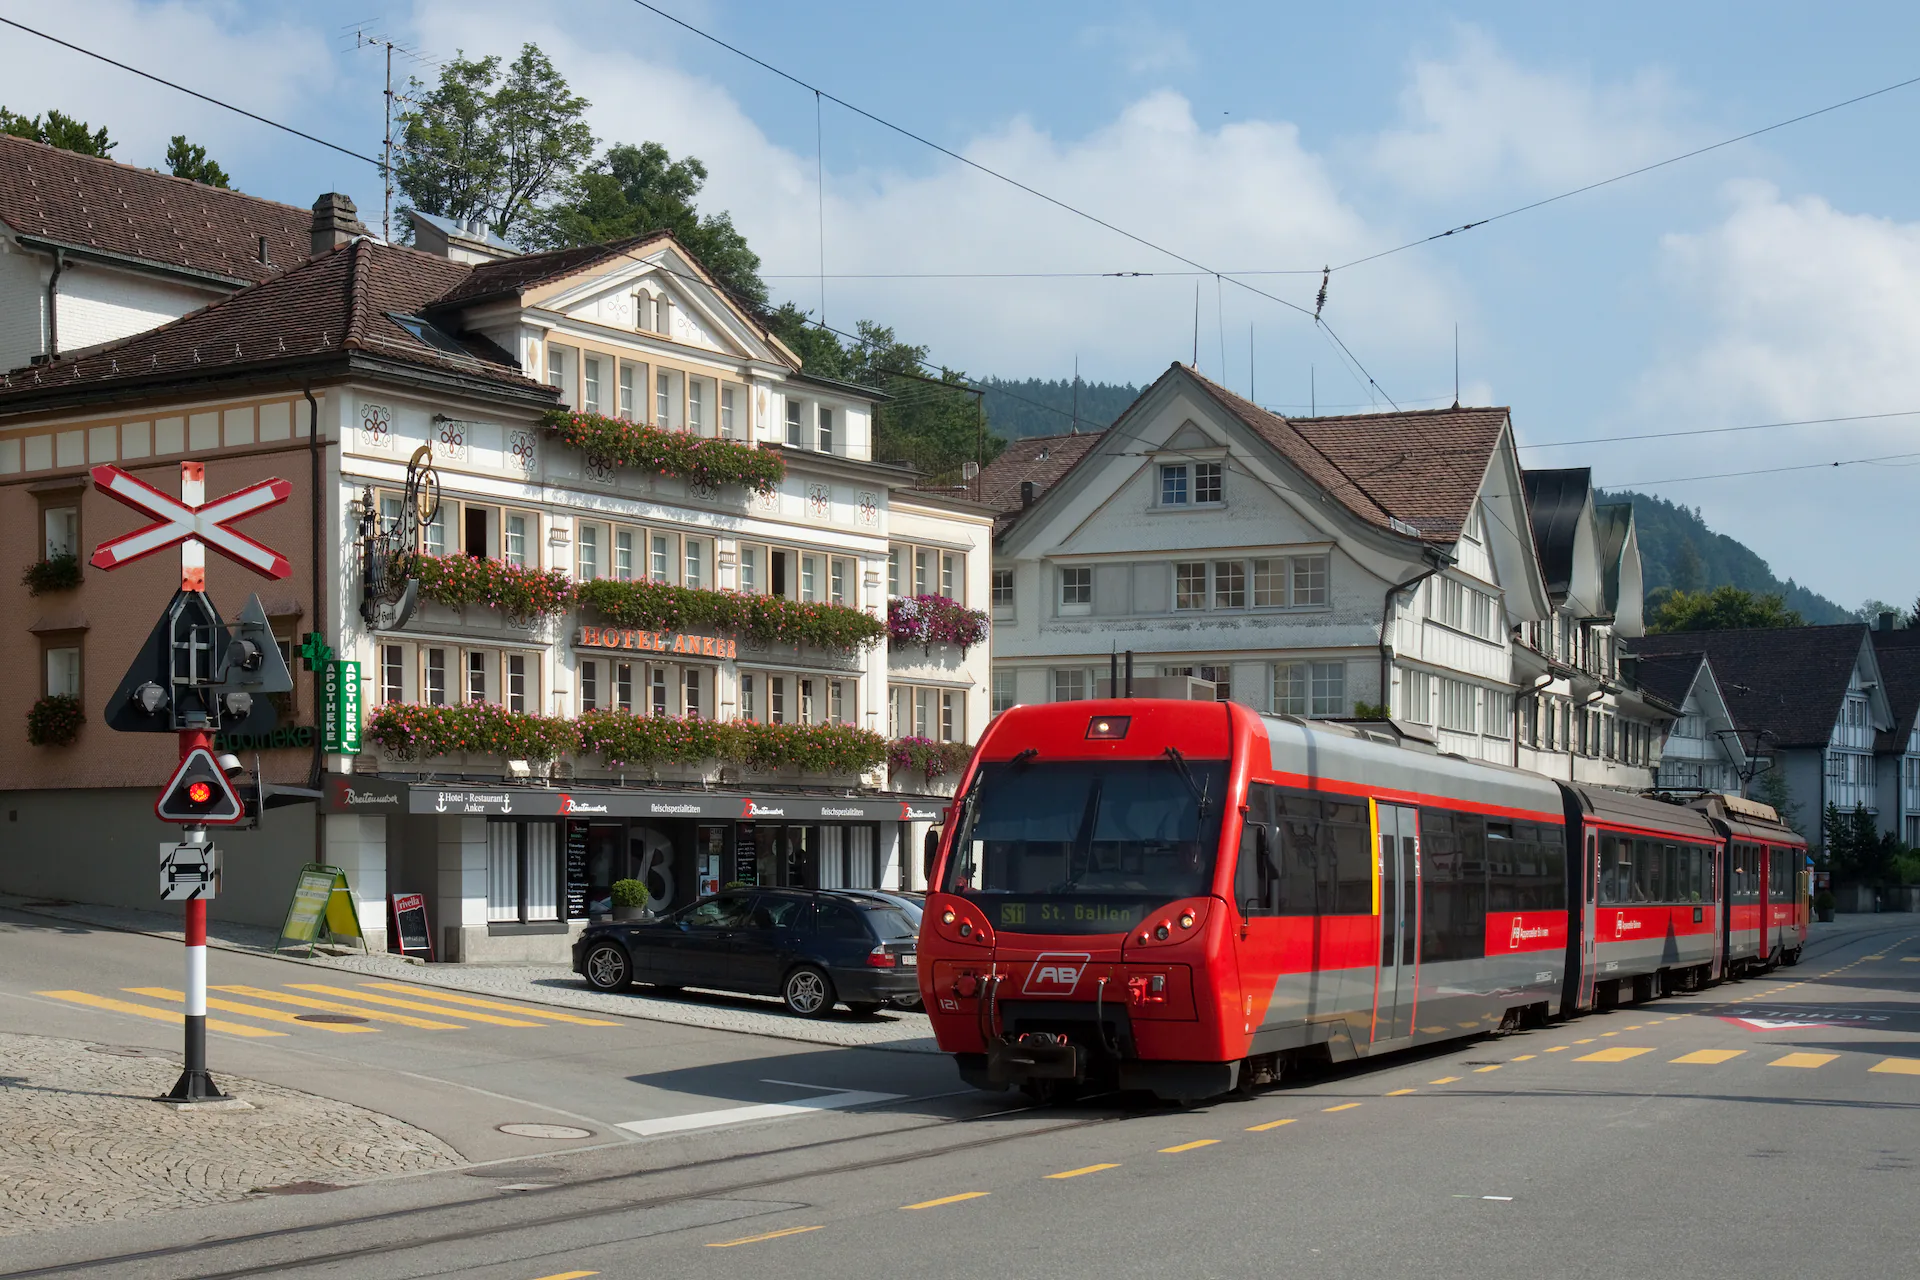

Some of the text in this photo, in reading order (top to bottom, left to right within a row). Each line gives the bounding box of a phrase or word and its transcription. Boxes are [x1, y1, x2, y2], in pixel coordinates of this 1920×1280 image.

[583, 625, 737, 660] HOTEL ANKER
[325, 663, 336, 741] APOTHEKE
[345, 663, 357, 742] APOTHEKE
[445, 793, 463, 802] Hotel
[470, 793, 503, 803] Restaurant
[464, 803, 485, 813] Anker
[399, 897, 420, 909] rivella
[1002, 904, 1131, 923] S11 St. Gallen
[1036, 967, 1078, 984] AB
[940, 999, 959, 1010] 121
